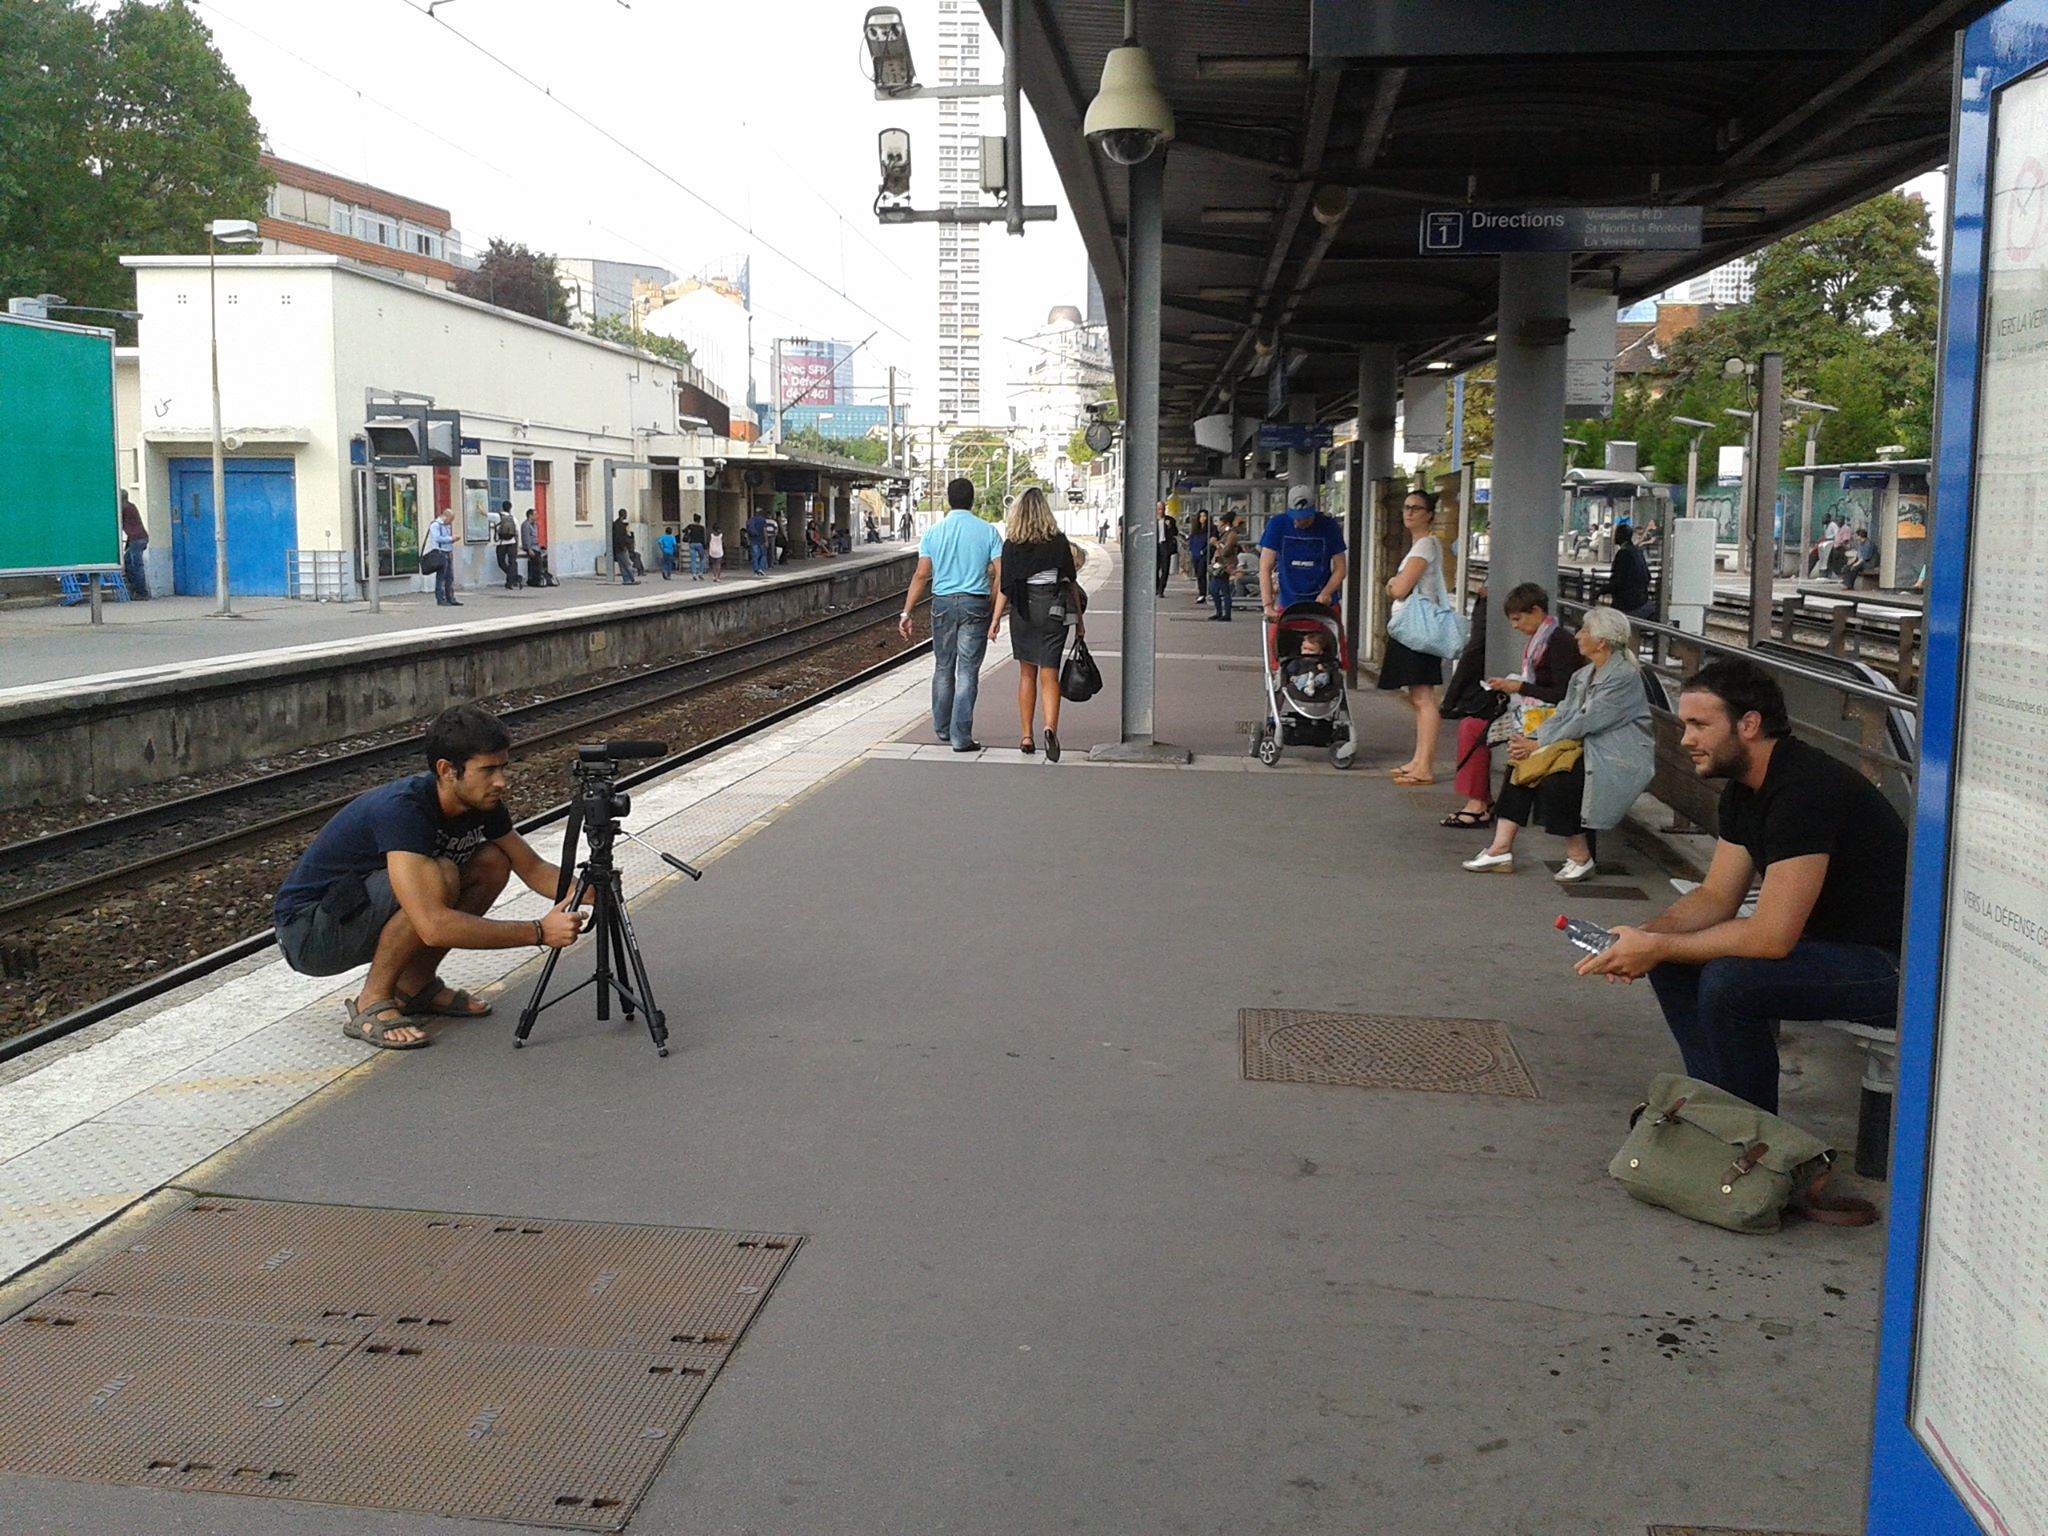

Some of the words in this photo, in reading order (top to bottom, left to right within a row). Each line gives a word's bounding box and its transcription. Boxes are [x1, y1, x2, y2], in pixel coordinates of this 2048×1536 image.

[1472, 211, 1565, 228] Directions
[1600, 223, 1627, 233] Nom
[1438, 225, 1447, 244] 1
[1963, 888, 1980, 913] VERS
[1982, 899, 1993, 919] LA
[1995, 905, 2036, 941] DÉFENSE
